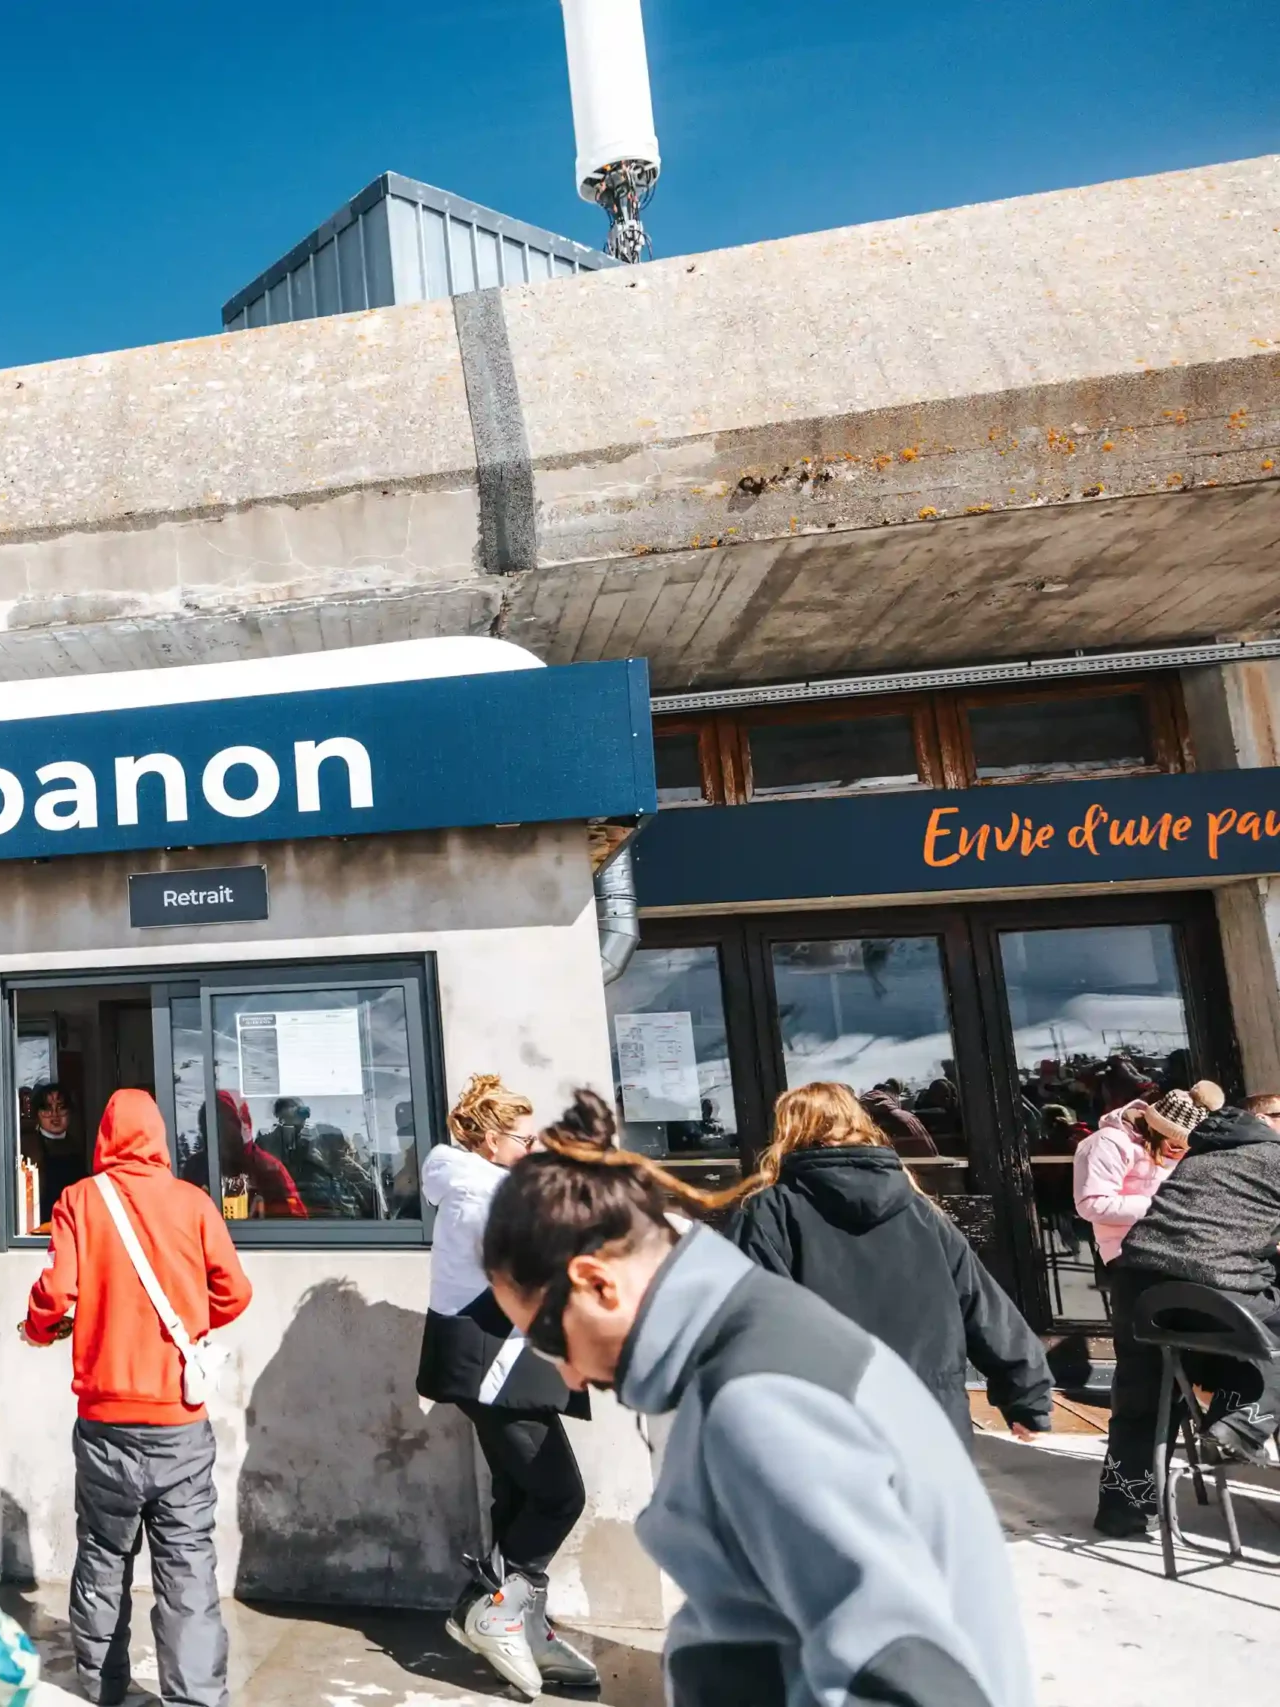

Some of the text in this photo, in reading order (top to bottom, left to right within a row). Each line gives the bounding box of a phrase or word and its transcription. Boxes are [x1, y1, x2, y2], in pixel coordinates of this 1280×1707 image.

[923, 807, 1055, 867] Envie
[1067, 803, 1193, 856] d'une
[163, 887, 234, 907] Retrait
